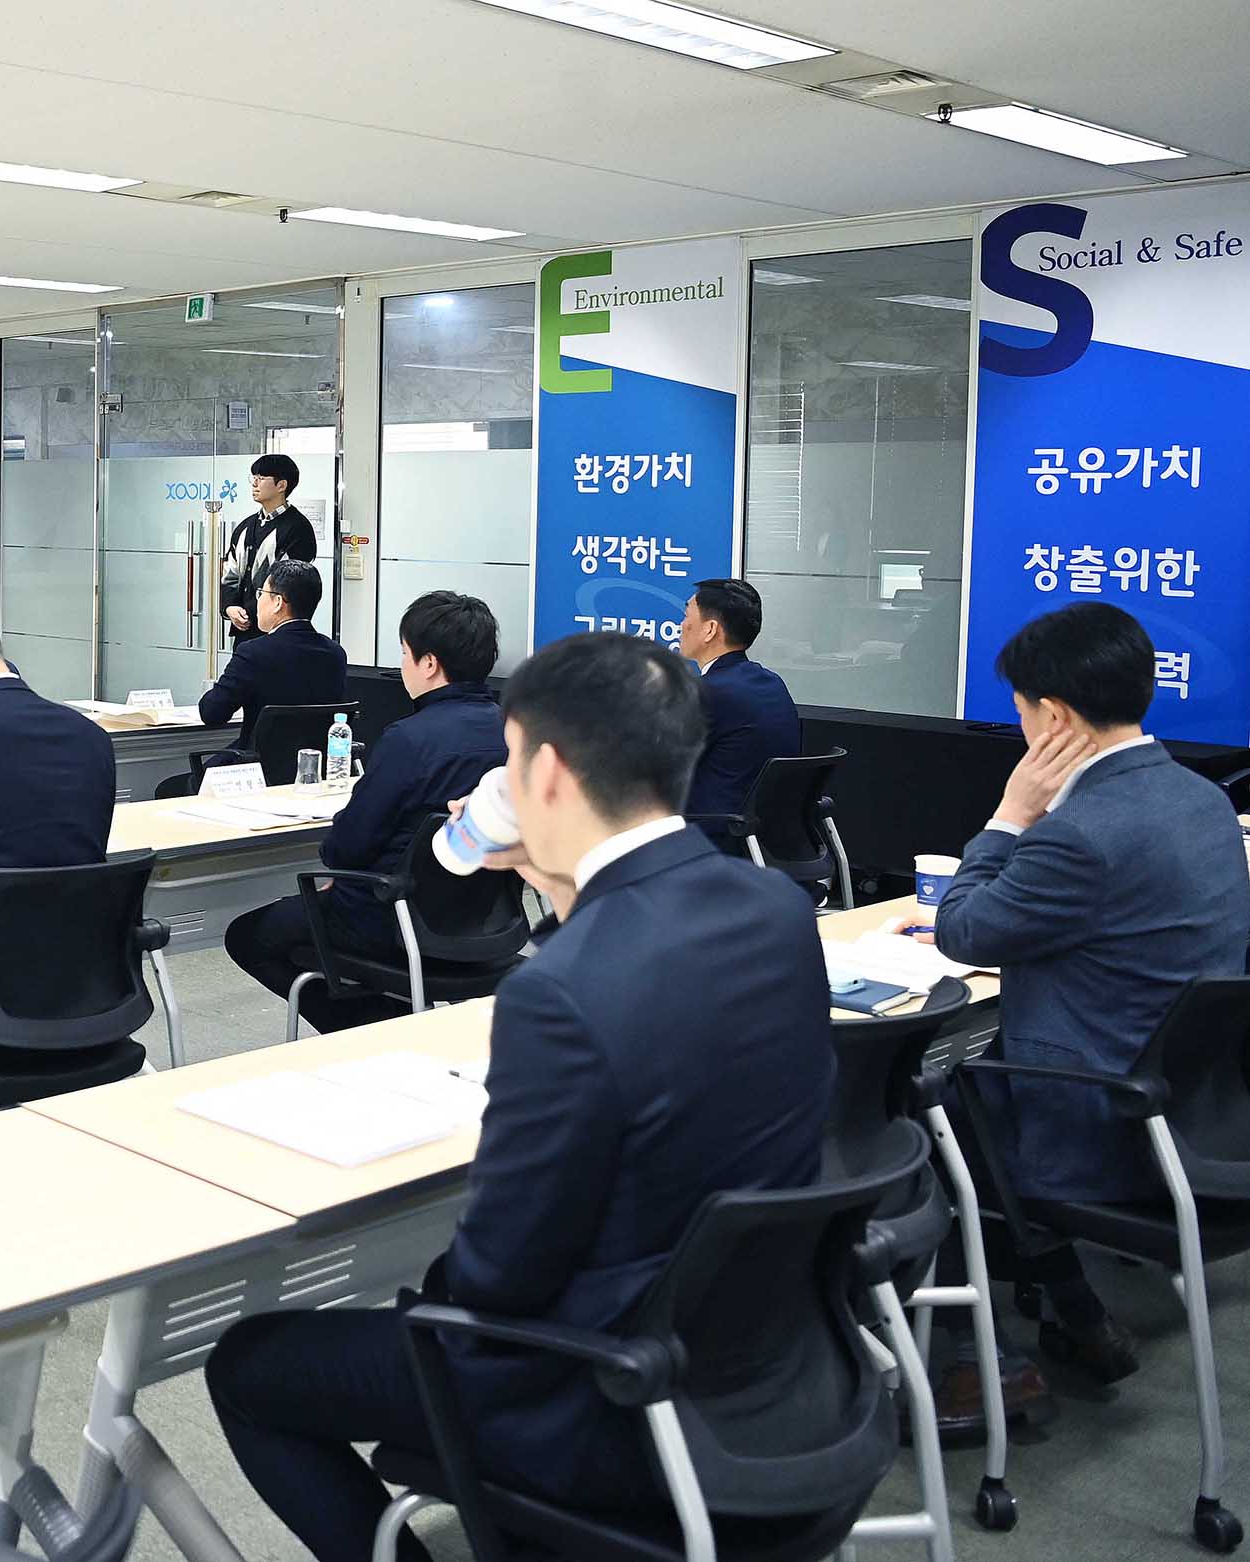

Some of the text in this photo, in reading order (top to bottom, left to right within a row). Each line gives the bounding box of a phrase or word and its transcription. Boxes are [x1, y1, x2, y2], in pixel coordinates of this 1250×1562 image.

[1039, 231, 1243, 272] Social & Safe
[574, 277, 724, 311] Environmental
[573, 452, 692, 494] 환경가치
[1027, 445, 1201, 495] 공유가치
[571, 535, 692, 577] 생각하는
[1023, 544, 1201, 598] 창출위한
